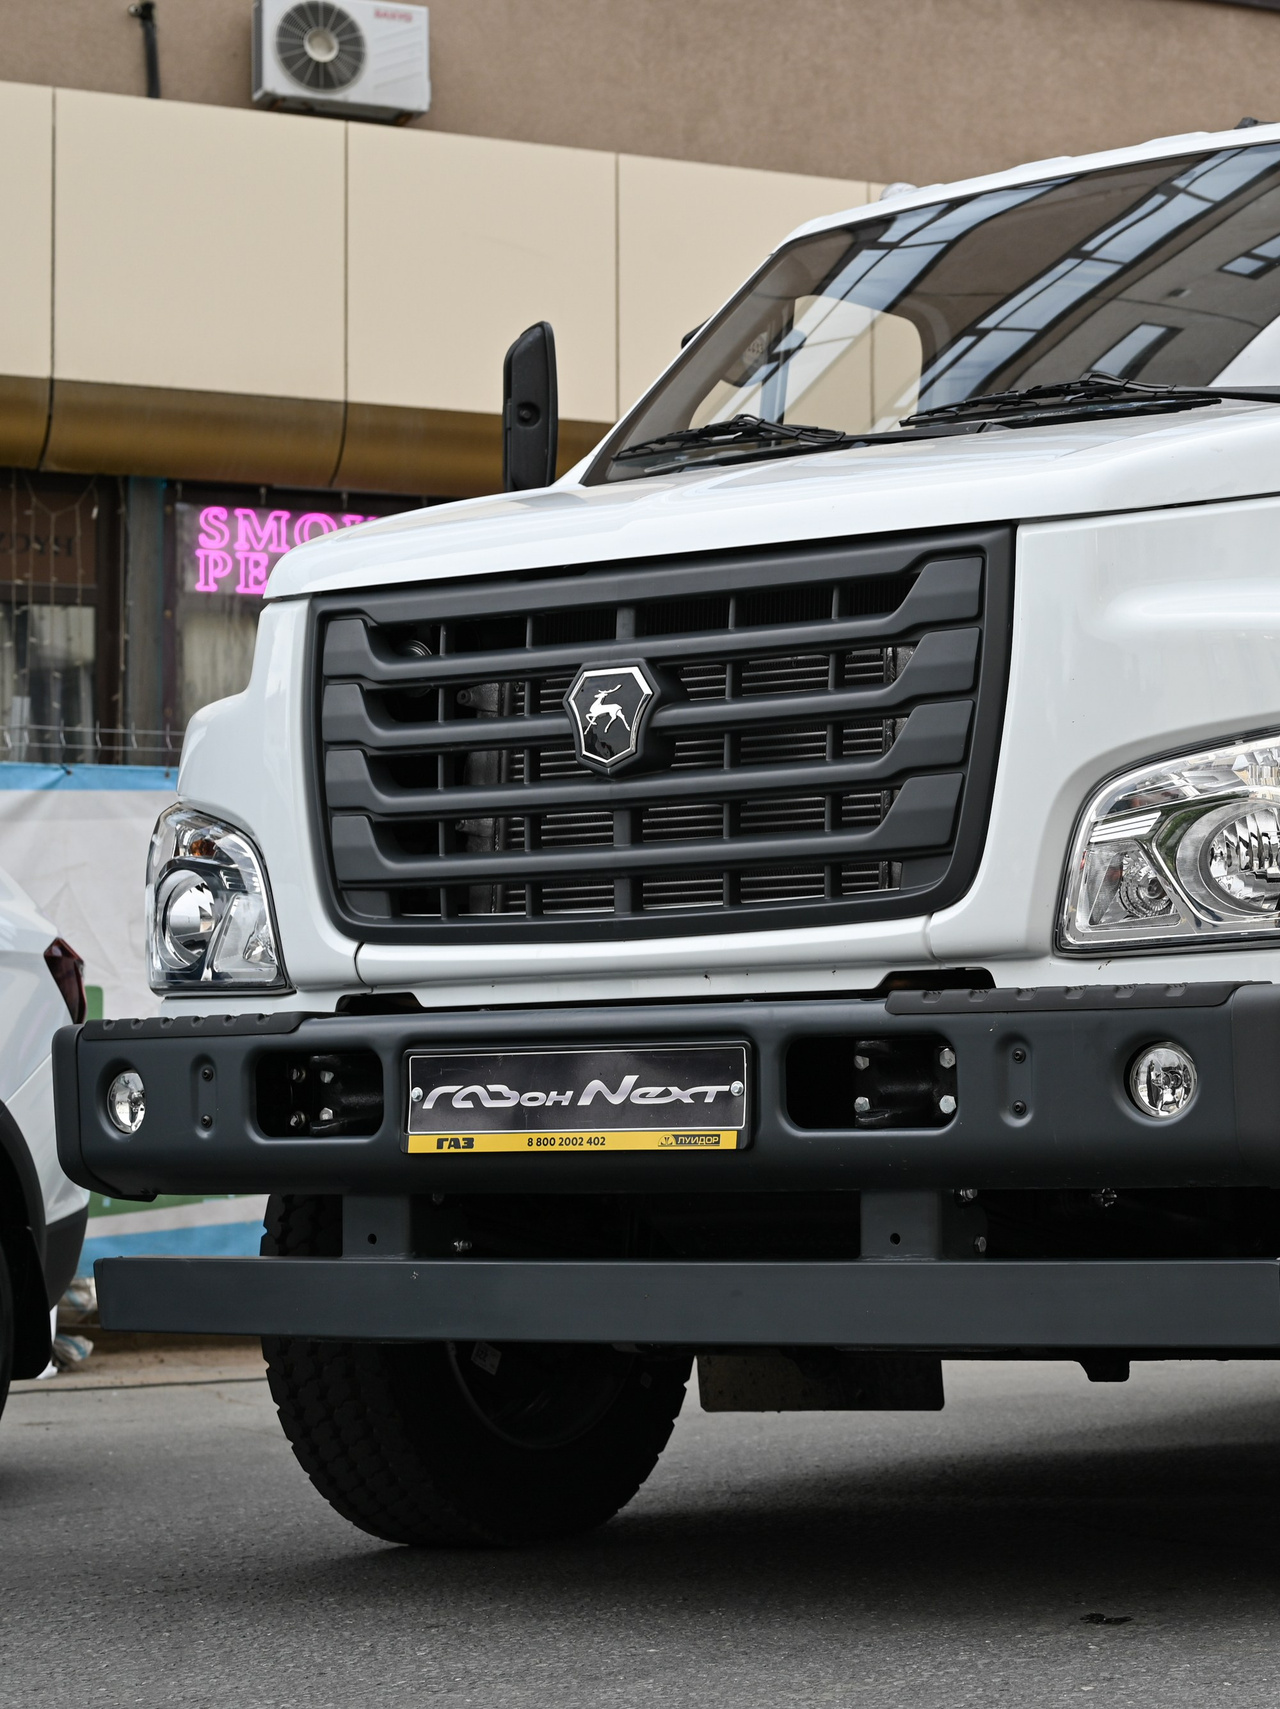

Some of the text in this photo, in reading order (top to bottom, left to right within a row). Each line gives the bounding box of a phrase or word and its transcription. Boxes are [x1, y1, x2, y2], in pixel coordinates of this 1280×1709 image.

[198, 506, 378, 552] SMO
[436, 1137, 475, 1150] ГАЗ
[527, 1136, 606, 1147] 8 800 2002 402
[677, 1136, 719, 1146] ЛУИДОР
